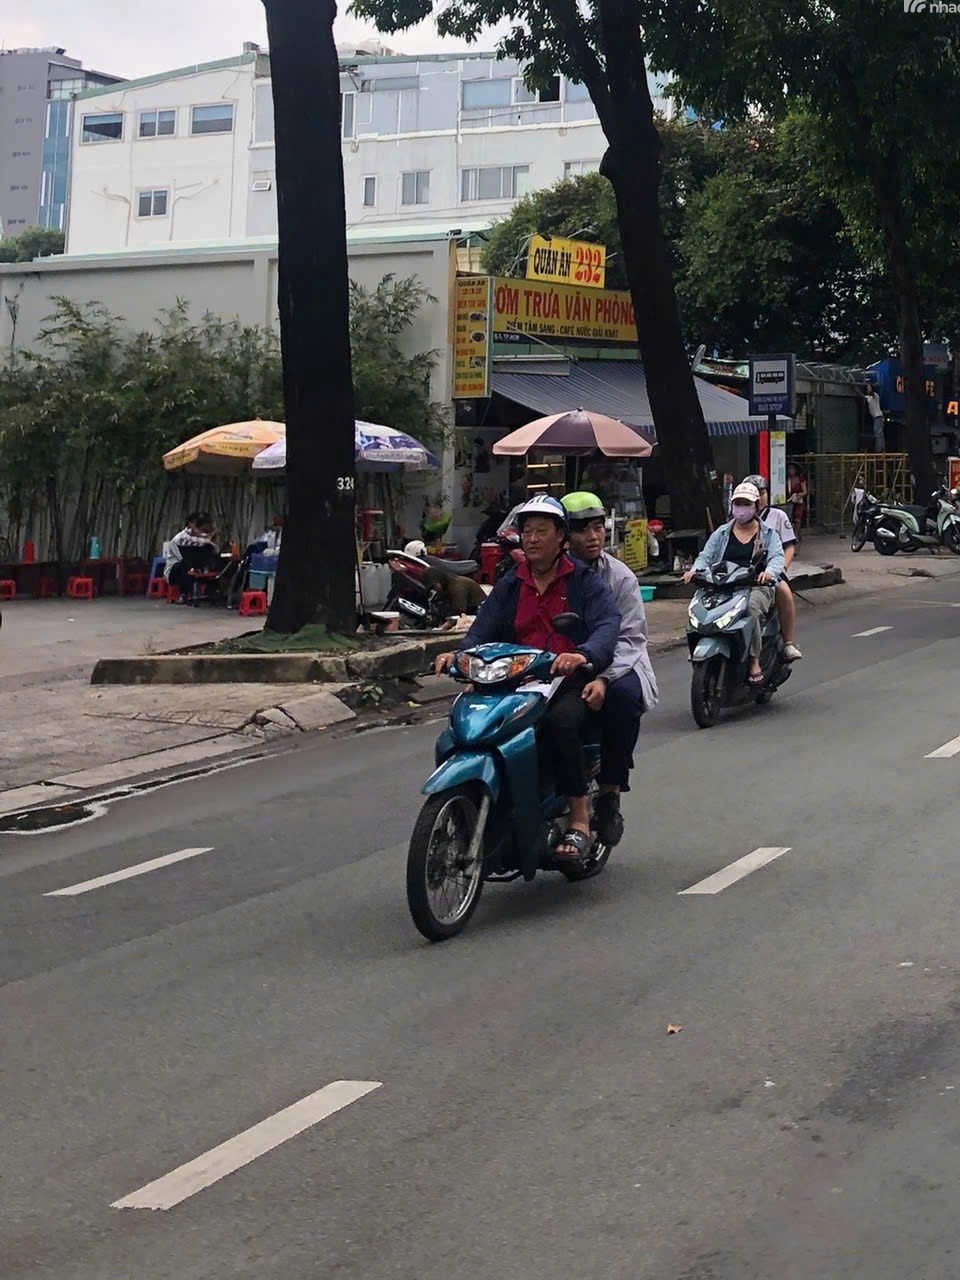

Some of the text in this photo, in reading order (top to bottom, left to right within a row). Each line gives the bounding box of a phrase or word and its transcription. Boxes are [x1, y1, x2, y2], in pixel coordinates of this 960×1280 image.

[574, 246, 602, 284] 232
[494, 283, 519, 315] ƠM
[524, 288, 560, 319] TRƯA
[565, 290, 591, 321] VĂN
